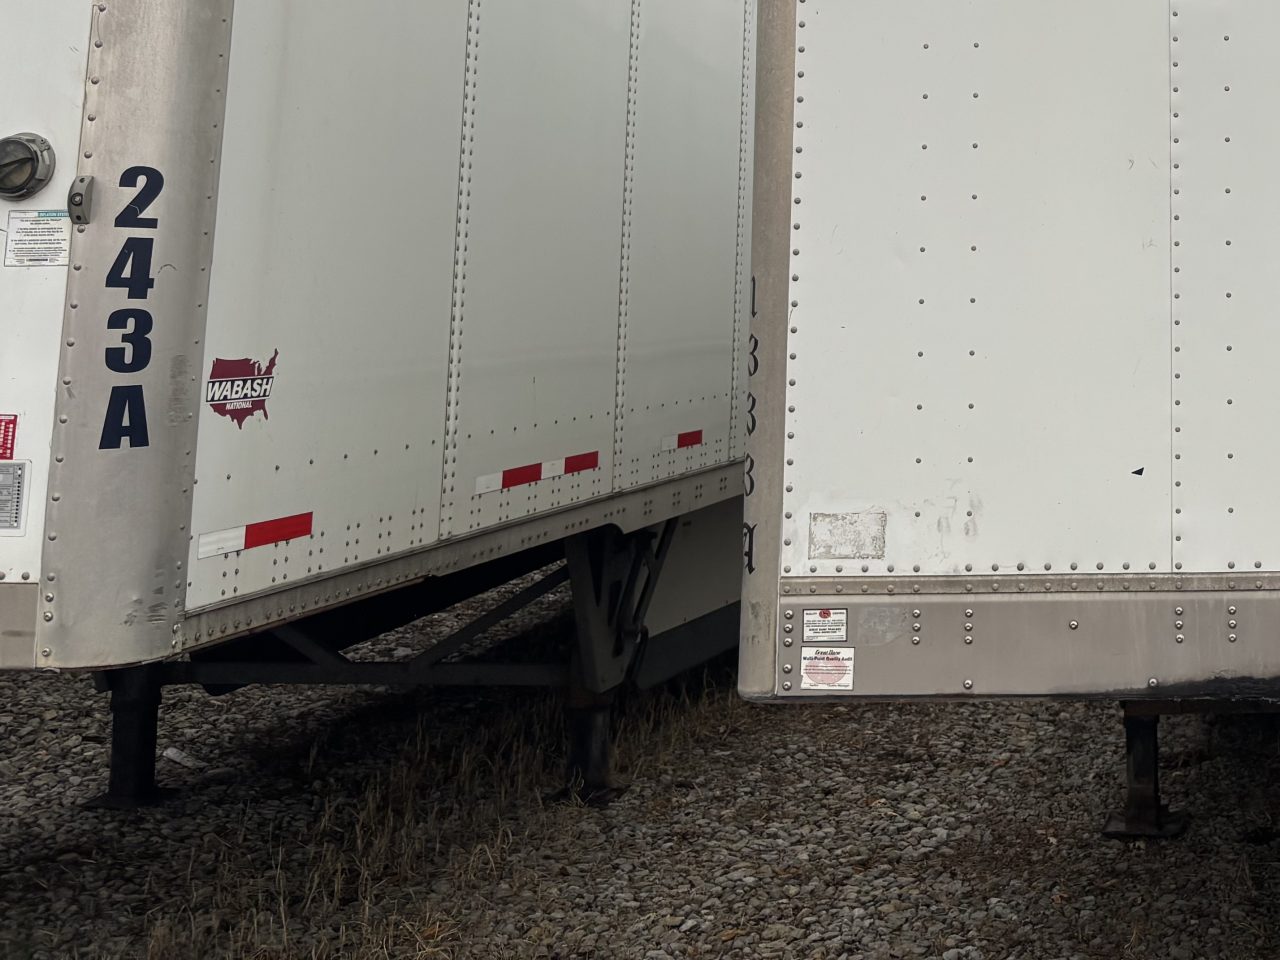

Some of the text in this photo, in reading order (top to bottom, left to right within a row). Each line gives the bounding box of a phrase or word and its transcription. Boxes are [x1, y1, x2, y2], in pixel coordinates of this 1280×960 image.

[99, 166, 164, 450] 243A
[207, 378, 273, 401] WABASH
[225, 401, 253, 410] NATIONAL
